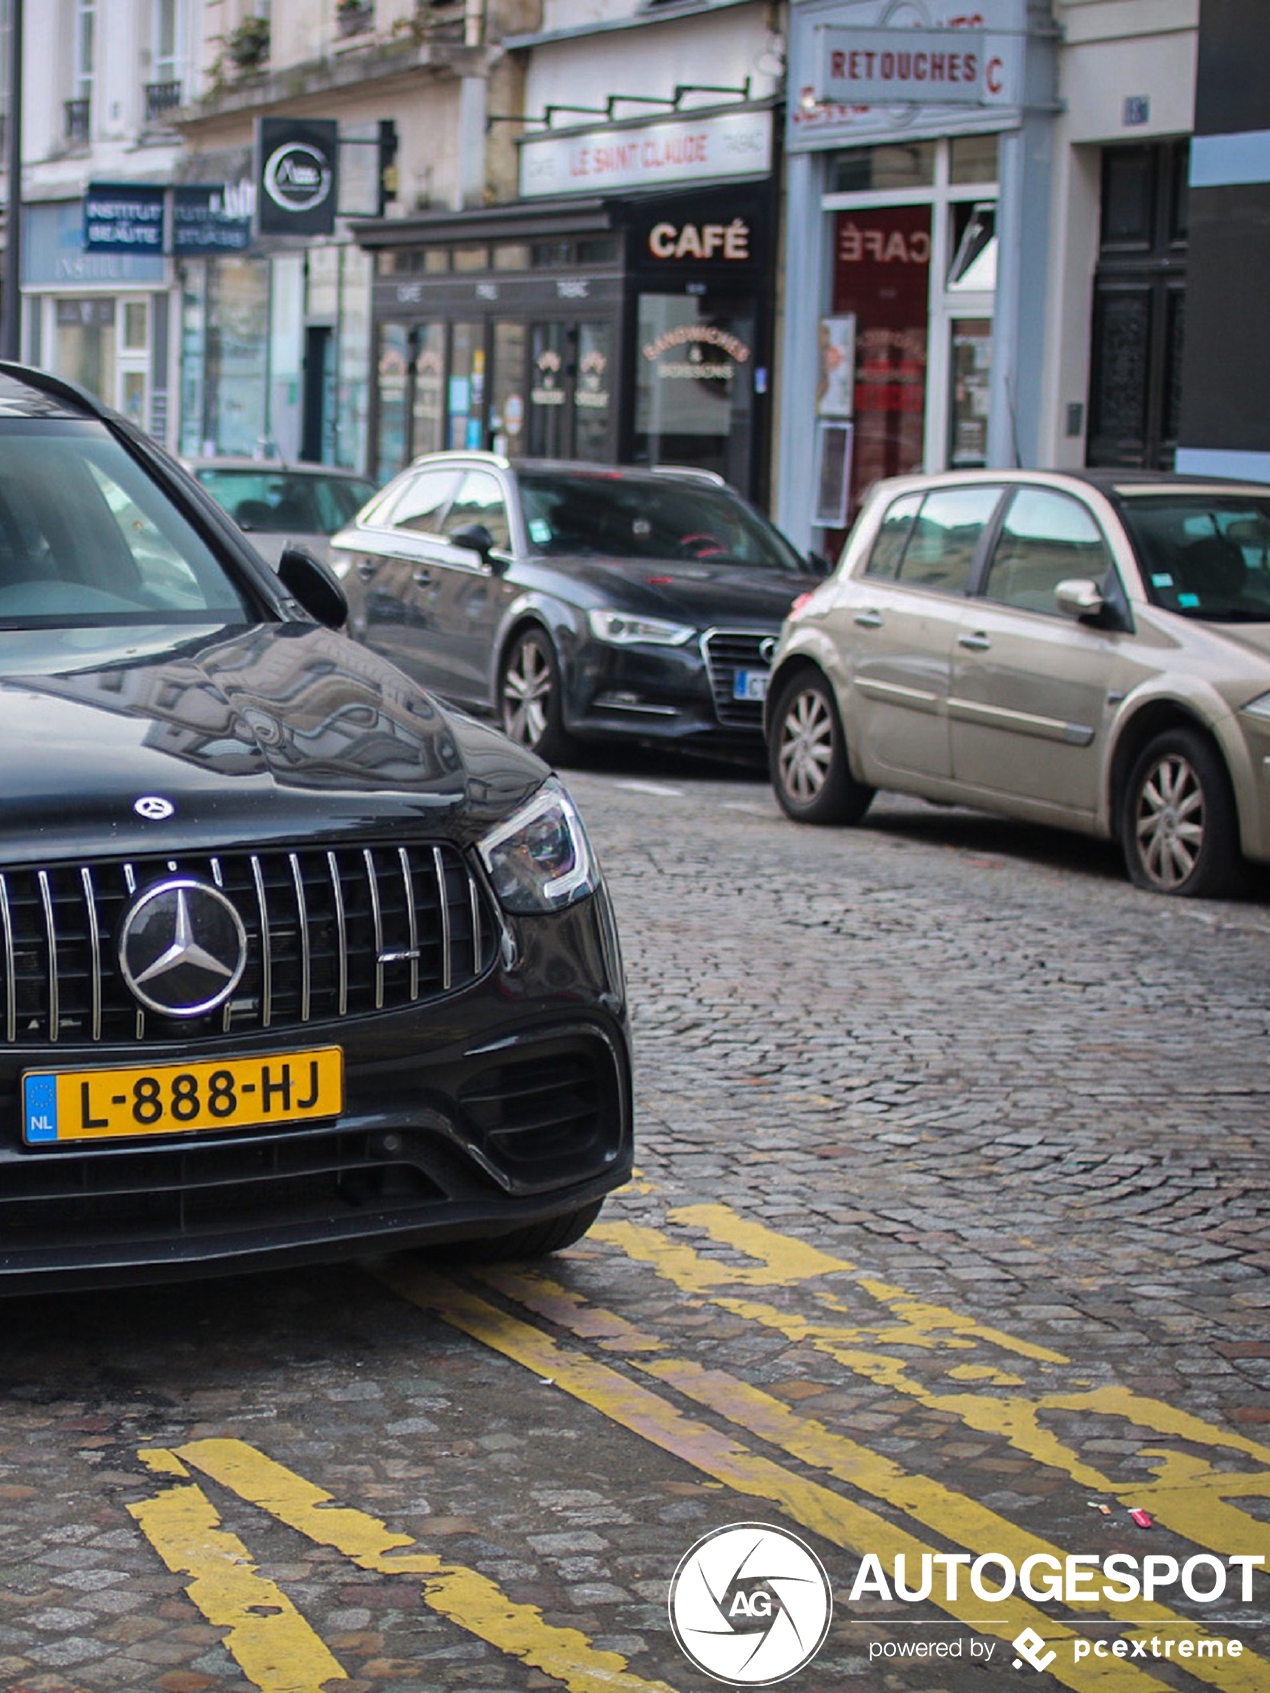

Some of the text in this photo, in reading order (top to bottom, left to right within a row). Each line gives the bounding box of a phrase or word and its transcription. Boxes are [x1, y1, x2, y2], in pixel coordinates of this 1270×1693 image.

[831, 50, 977, 82] RETOUCHES
[569, 147, 589, 176] LE
[593, 141, 639, 173] SAINT
[643, 133, 709, 168] CLAUDE
[86, 202, 161, 220] INSTITUT
[649, 218, 750, 259] CAFÉ
[80, 1060, 319, 1130] L-888-HJ
[30, 1116, 53, 1131] NL
